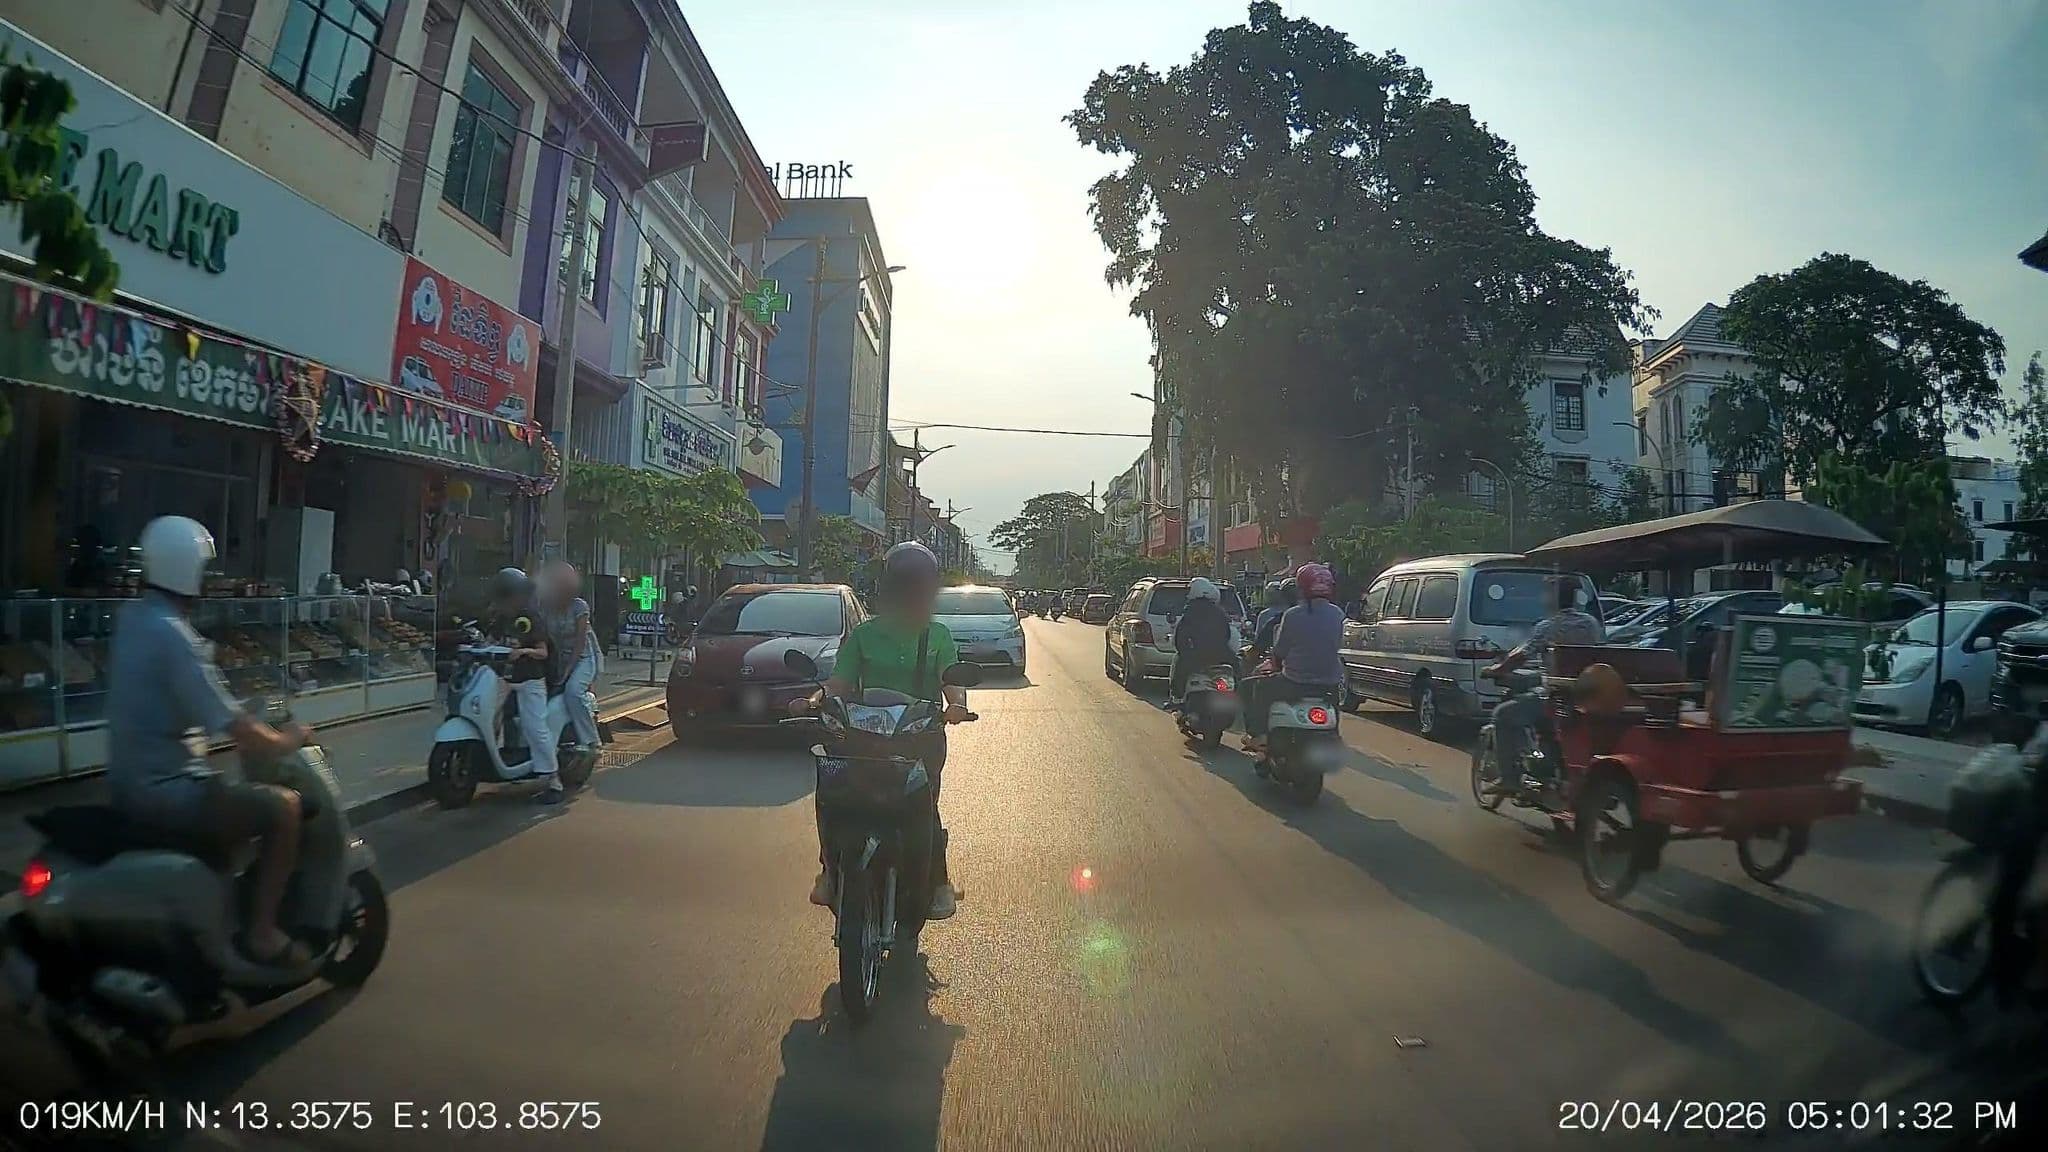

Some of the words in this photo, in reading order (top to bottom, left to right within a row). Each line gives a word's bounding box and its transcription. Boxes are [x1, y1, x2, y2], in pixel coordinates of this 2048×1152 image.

[787, 160, 853, 180] Bank
[84, 148, 240, 274] MART
[321, 393, 389, 439] AKE
